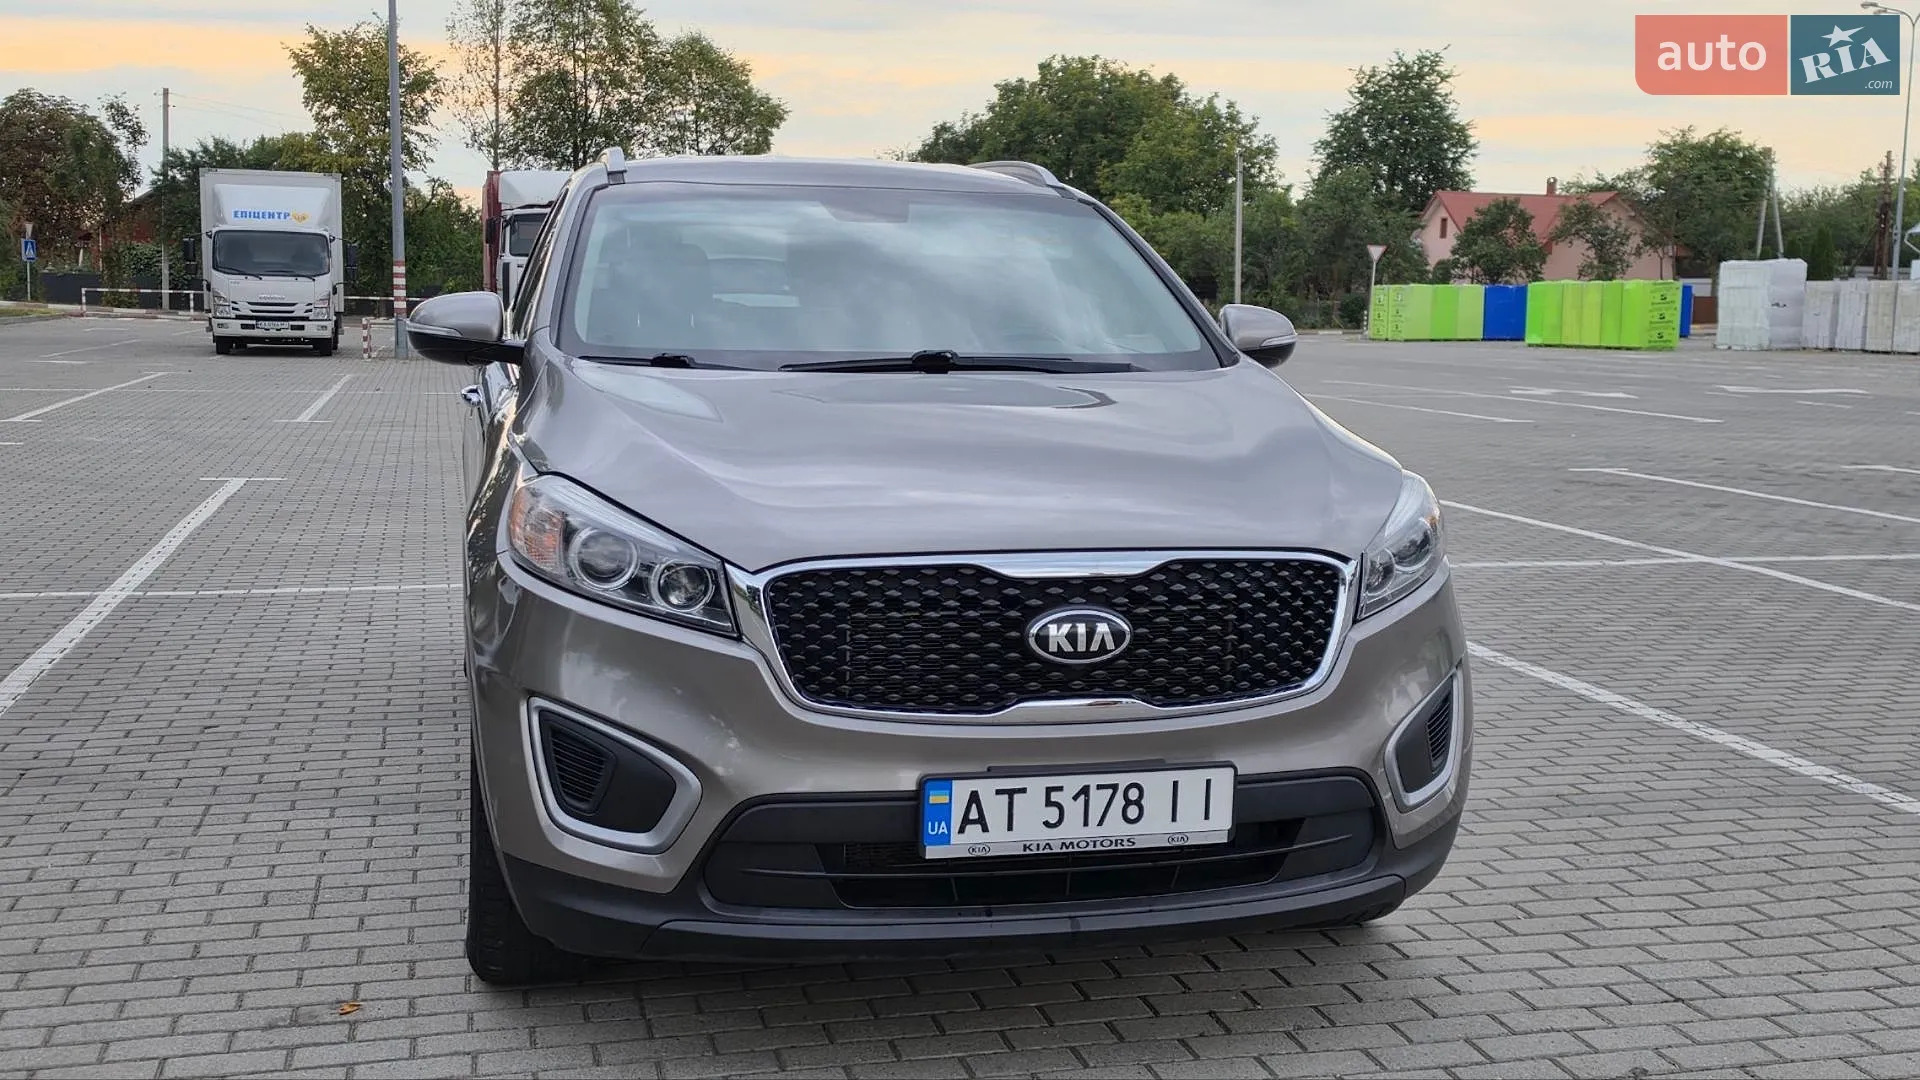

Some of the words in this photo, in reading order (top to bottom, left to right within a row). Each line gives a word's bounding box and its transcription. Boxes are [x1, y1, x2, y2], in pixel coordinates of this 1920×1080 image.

[233, 210, 291, 220] ЕПІЦЕНТР
[1047, 622, 1115, 652] KIA
[958, 787, 1027, 834] AT
[1042, 782, 1144, 829] 5178
[928, 821, 948, 835] UA
[1022, 842, 1053, 853] KIA
[1059, 837, 1136, 850] MOTORS
[1169, 835, 1187, 845] KIA
[971, 846, 988, 854] KIA
